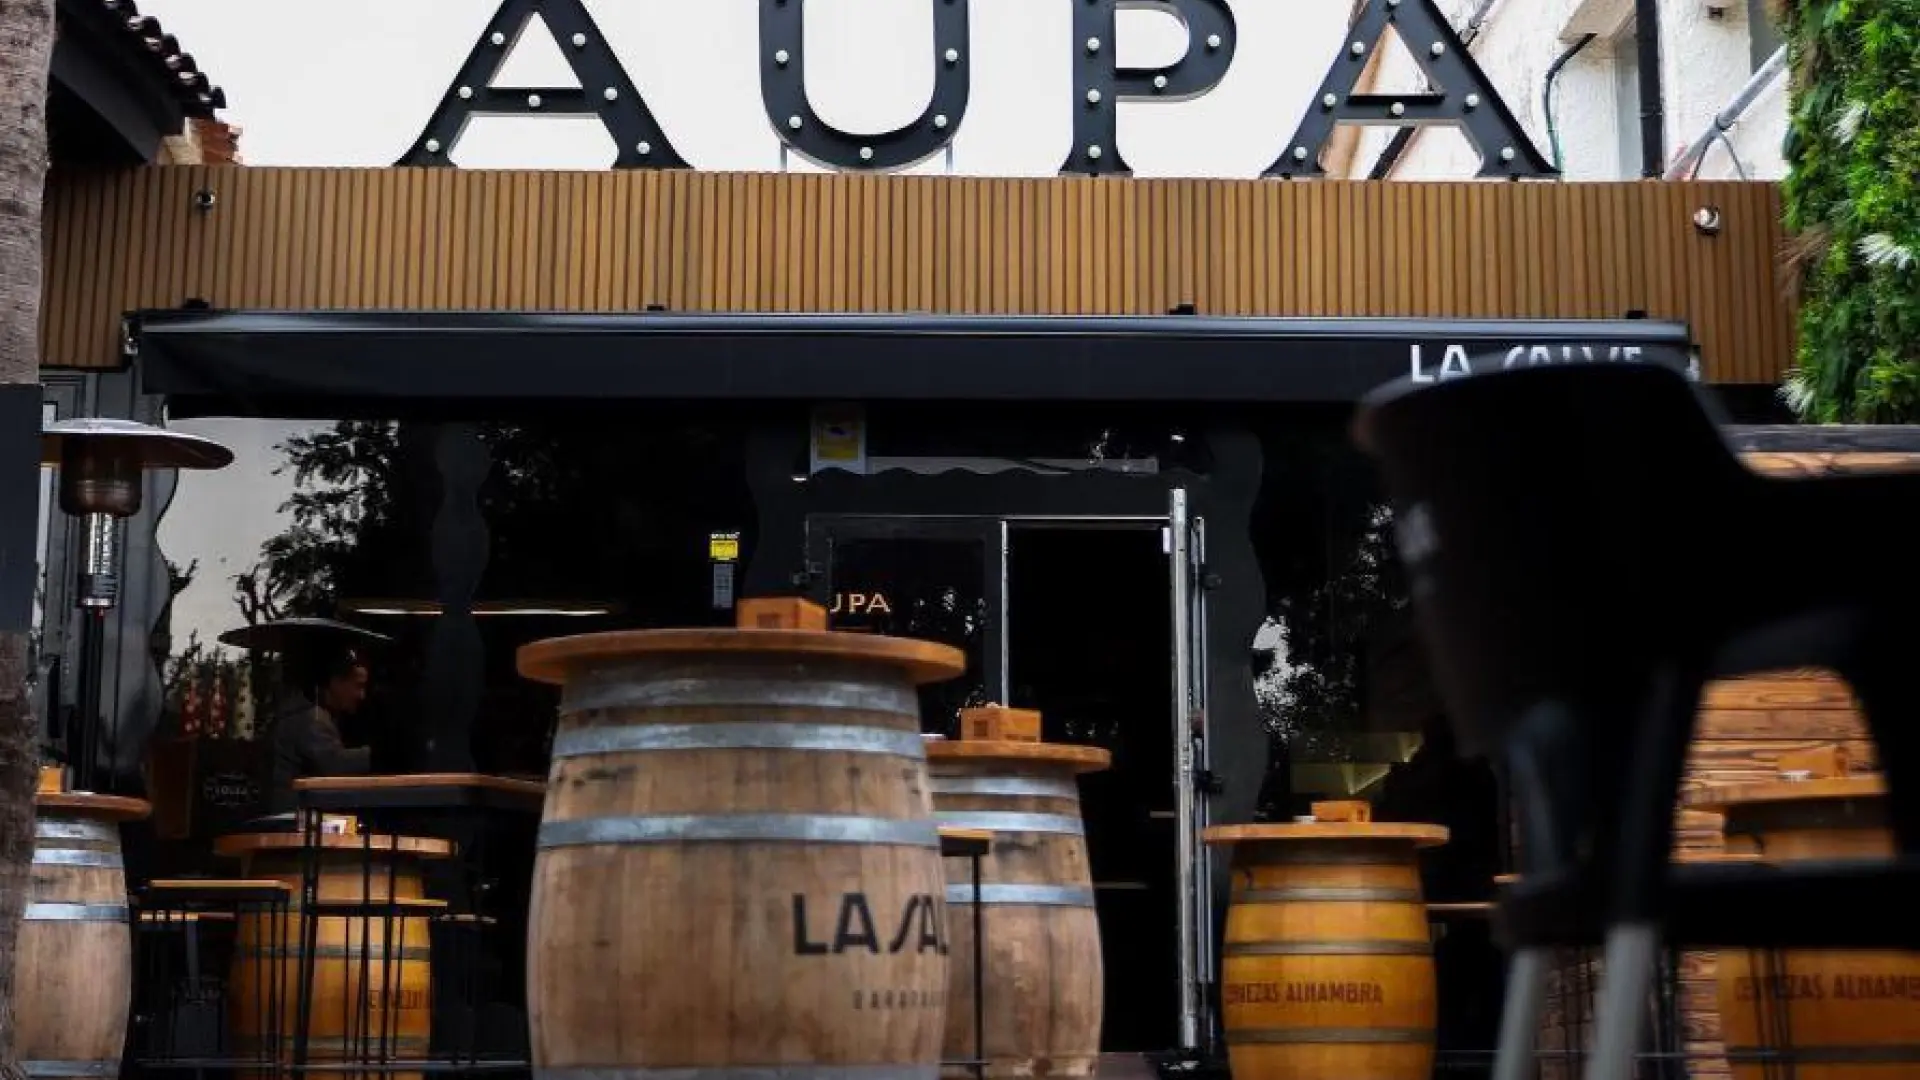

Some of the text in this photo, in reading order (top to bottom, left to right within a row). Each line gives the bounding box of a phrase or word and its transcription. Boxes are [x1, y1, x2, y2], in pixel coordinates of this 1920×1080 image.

[392, 0, 1561, 181] AUPA
[1410, 344, 1471, 383] LA
[792, 892, 949, 955] LA SA
[1284, 980, 1383, 1005] ALHAMBRA
[1734, 973, 1826, 1003] CEVEZAS
